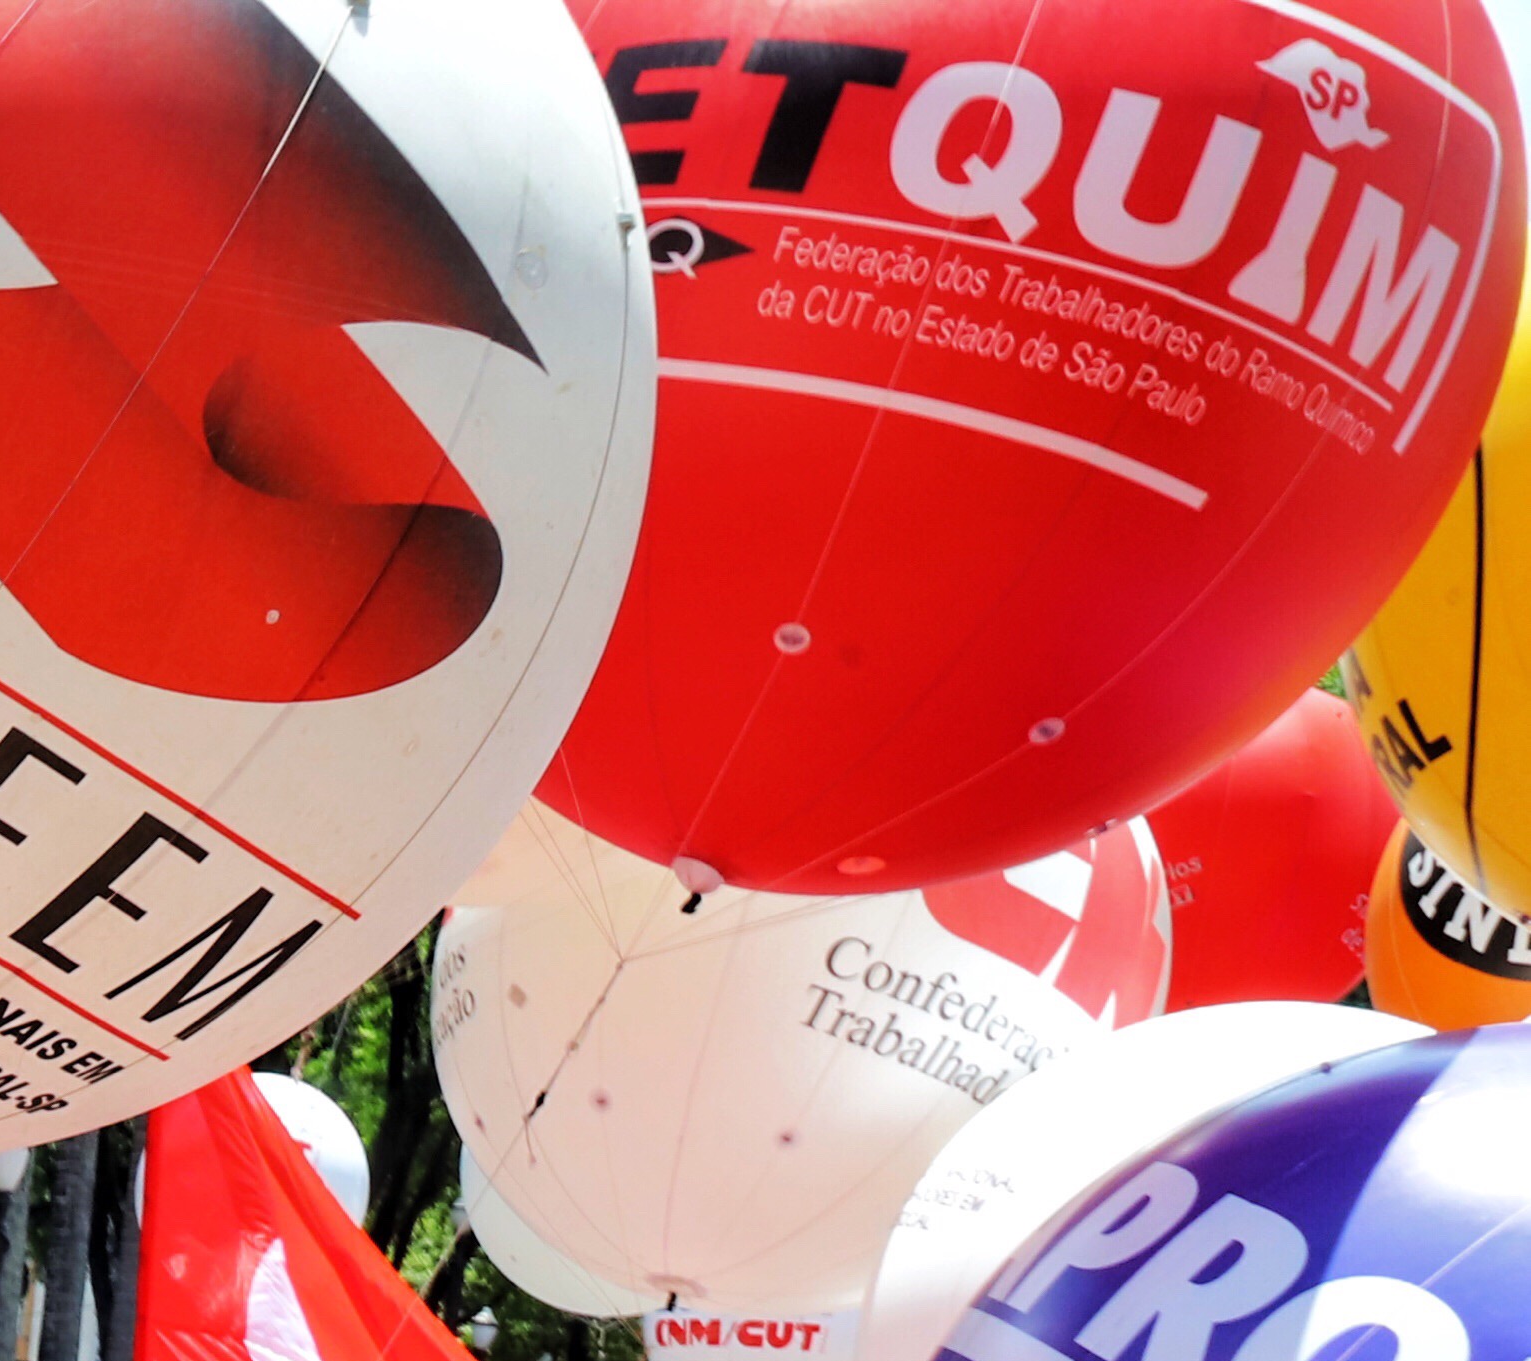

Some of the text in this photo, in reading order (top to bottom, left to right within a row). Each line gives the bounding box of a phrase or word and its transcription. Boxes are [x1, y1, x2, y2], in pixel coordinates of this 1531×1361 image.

[1307, 65, 1361, 119] SP
[757, 278, 1207, 428] da CUT no Estado de São Paulo
[773, 224, 929, 287] Federação
[936, 259, 991, 299] dos
[998, 263, 1204, 362] Trabalhadores
[1206, 334, 1241, 379] do
[1239, 346, 1306, 412] Ramo
[62, 1055, 123, 1086] EM
